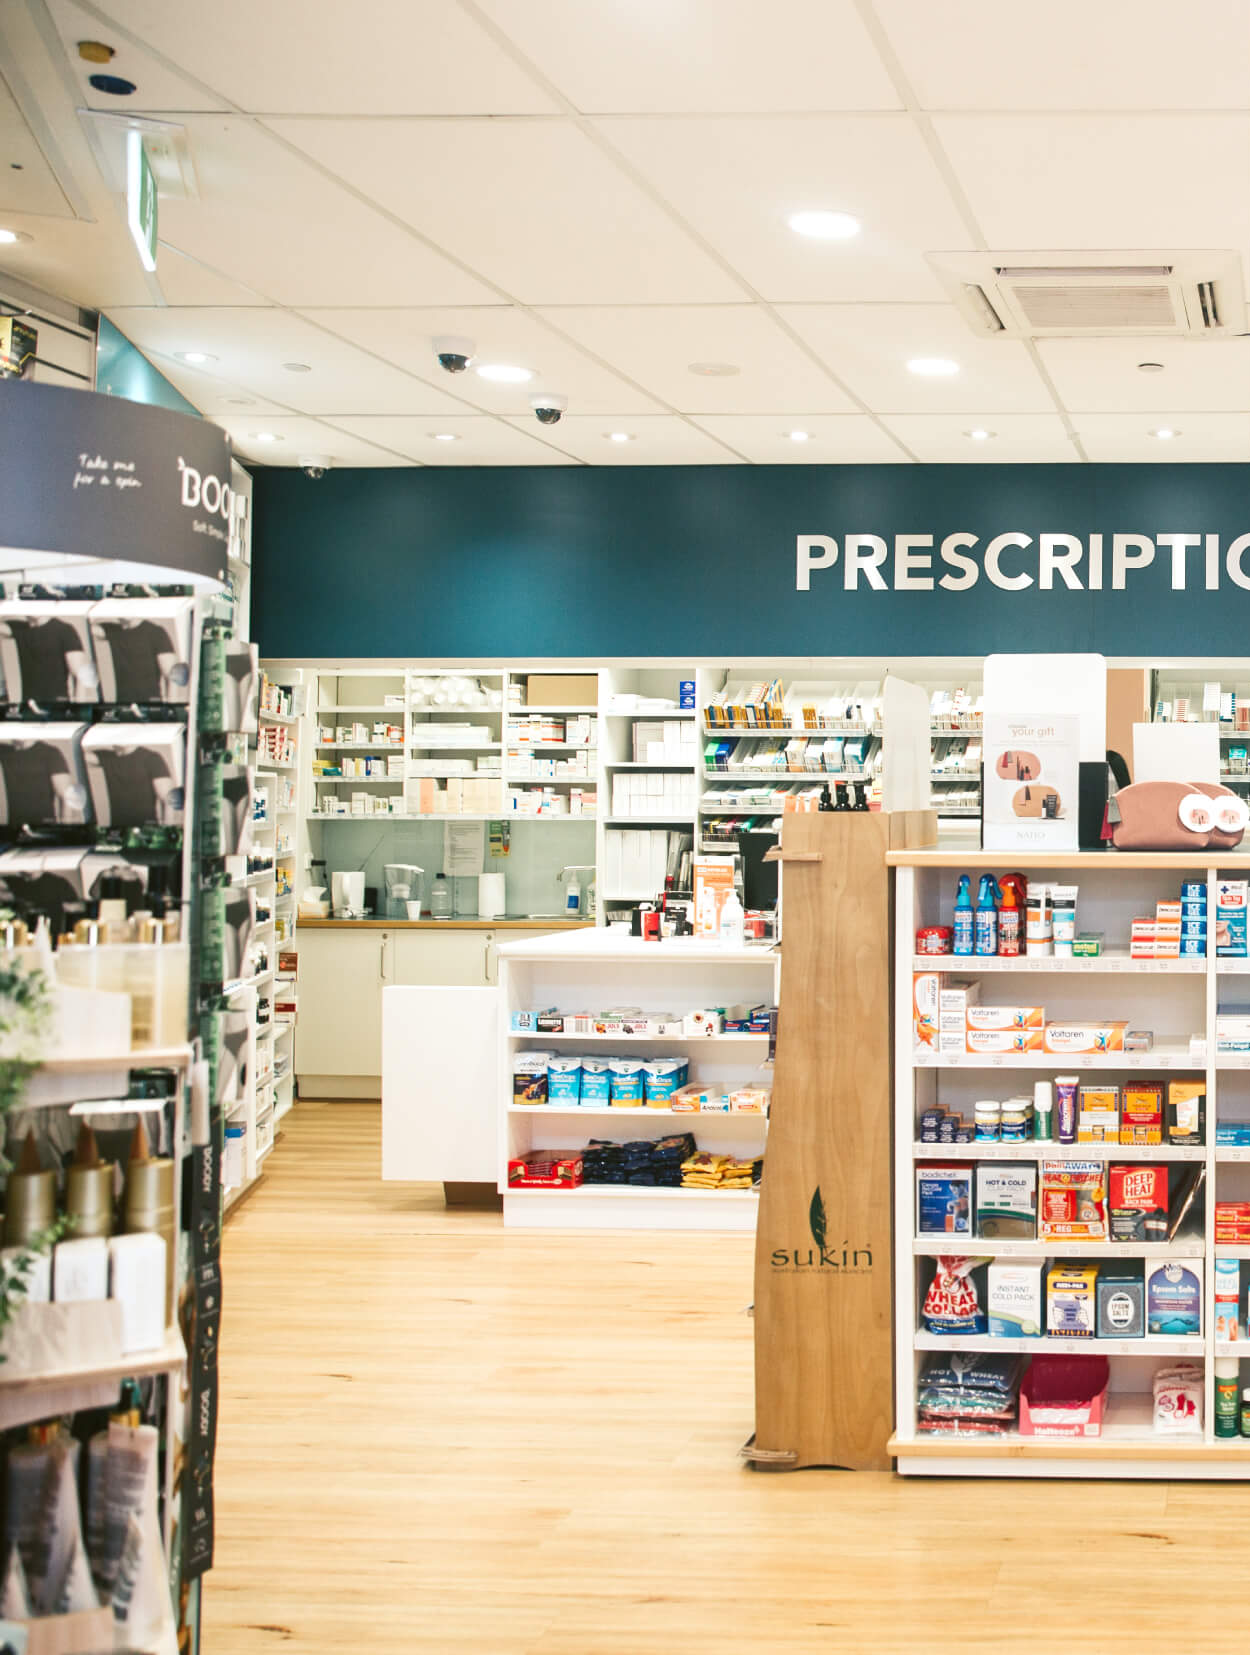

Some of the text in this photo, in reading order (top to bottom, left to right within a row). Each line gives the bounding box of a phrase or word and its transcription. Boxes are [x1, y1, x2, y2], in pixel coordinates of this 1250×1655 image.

[79, 453, 136, 472] Take me
[1012, 727, 1034, 737] your
[1037, 726, 1055, 737] gift
[1050, 1030, 1084, 1038] Voltaren
[1126, 1173, 1153, 1185] DEEP
[1126, 1183, 1153, 1197] HEAT
[771, 1240, 873, 1266] sukin
